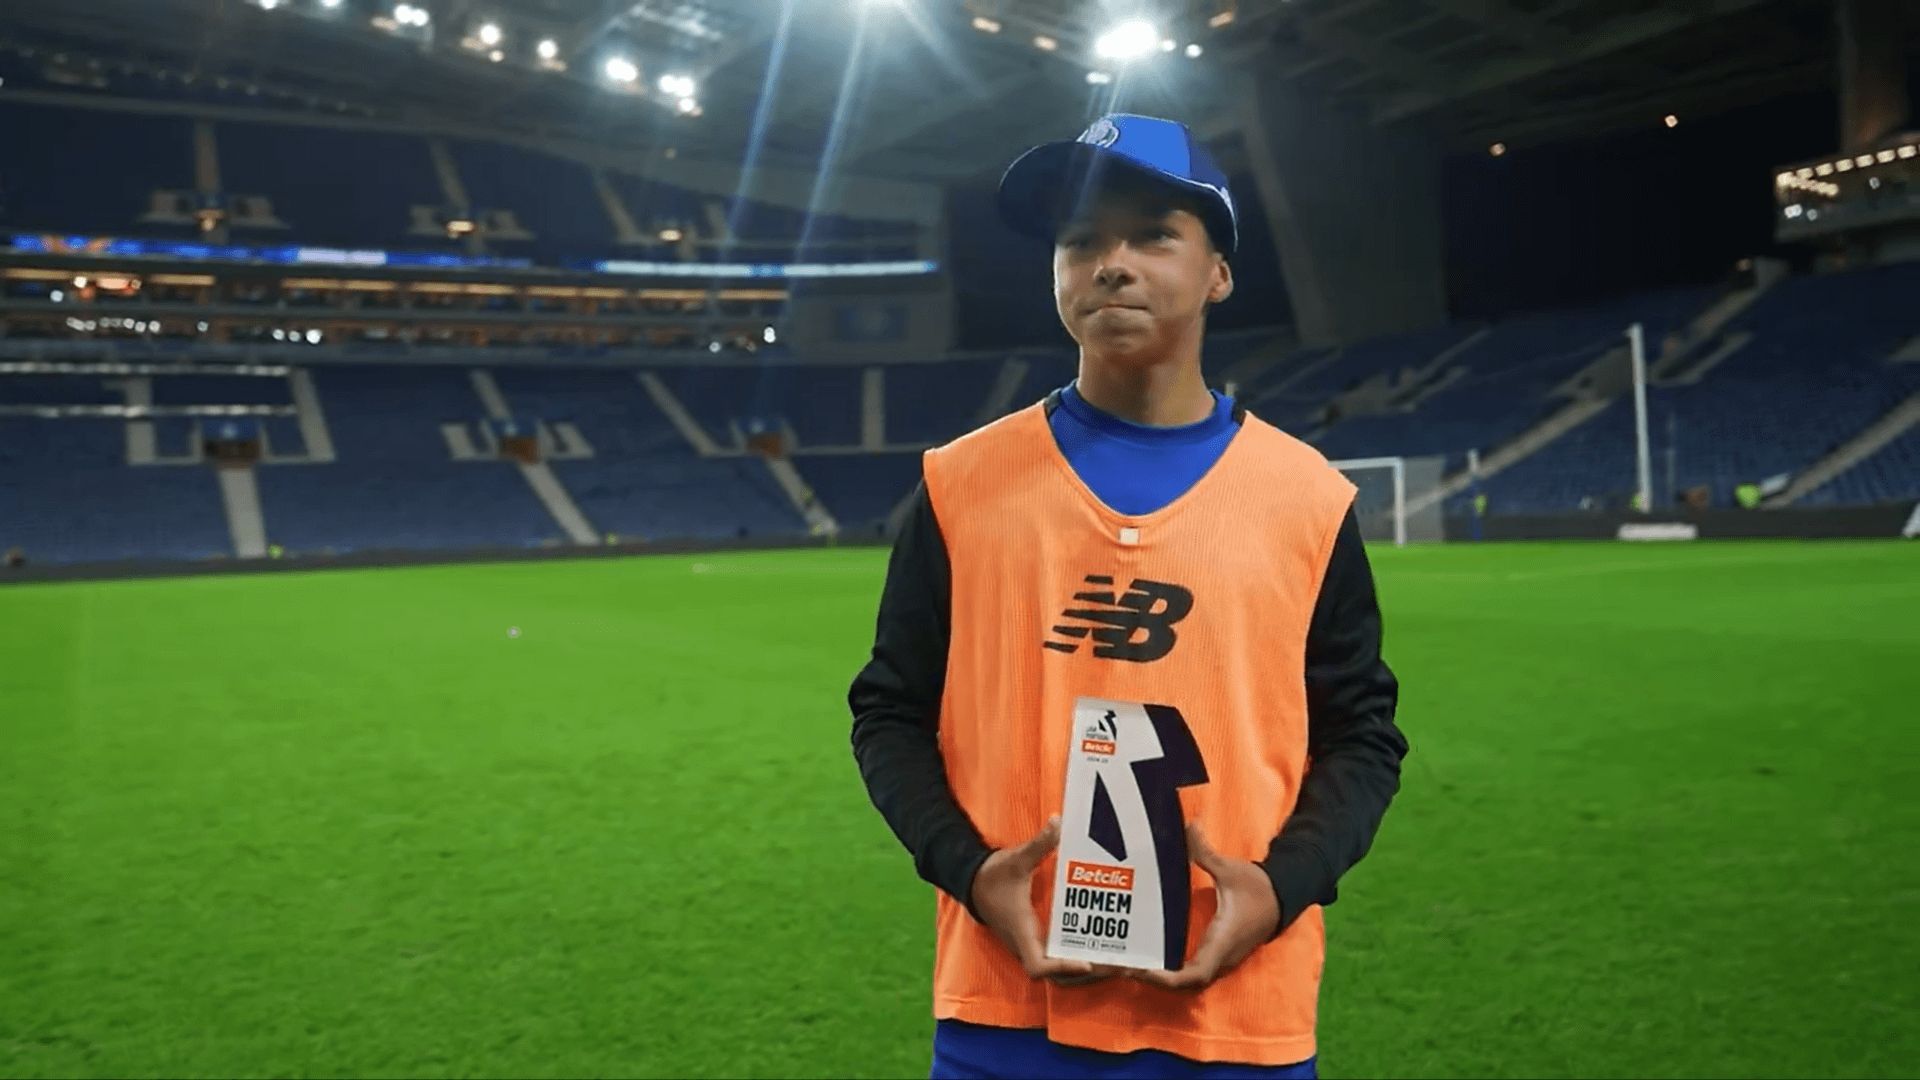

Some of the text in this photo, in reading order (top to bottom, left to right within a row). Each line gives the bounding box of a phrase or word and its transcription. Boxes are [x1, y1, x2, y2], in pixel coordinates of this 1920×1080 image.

[1043, 574, 1194, 663] NB
[1072, 866, 1129, 886] Betclic
[1065, 887, 1132, 914] HOMEM
[1062, 912, 1129, 939] DO JOGO
